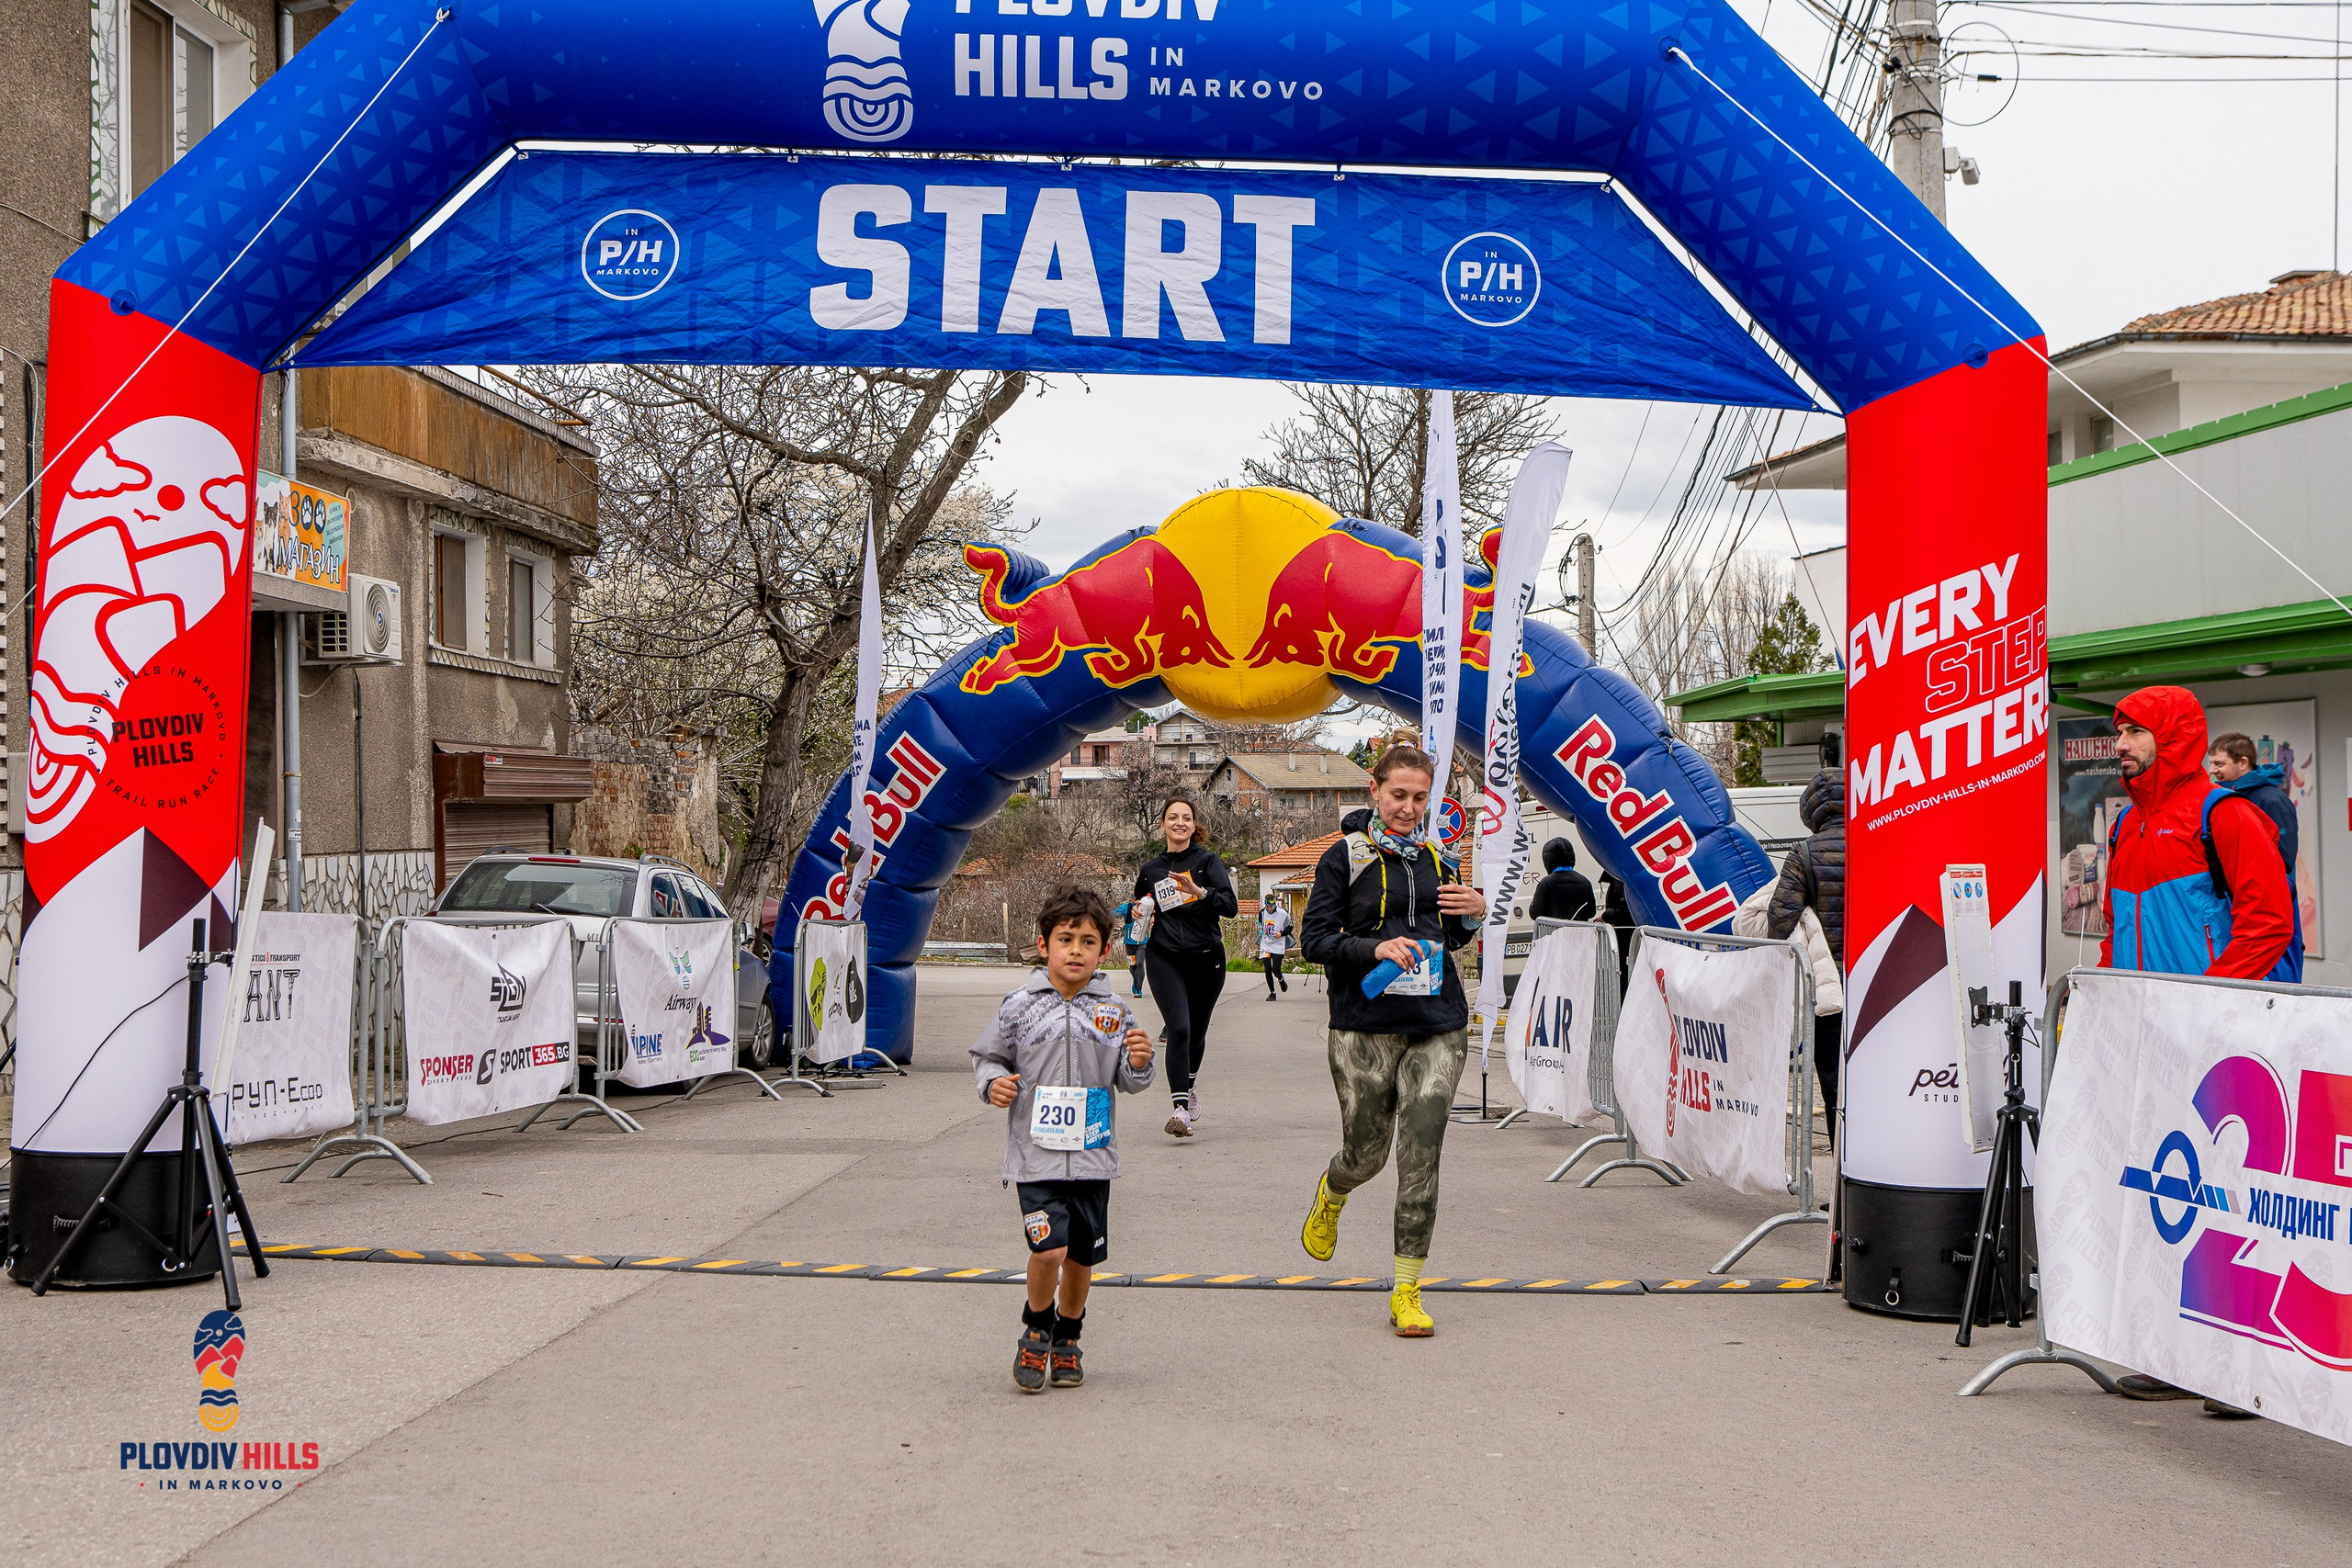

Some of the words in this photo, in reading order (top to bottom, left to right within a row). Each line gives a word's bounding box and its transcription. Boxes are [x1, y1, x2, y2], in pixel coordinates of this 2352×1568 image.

[955, 33, 1128, 100] HILLS
[1150, 47, 1183, 66] IN
[1150, 77, 1323, 100] MARKOVO
[599, 240, 663, 266] P/H
[809, 185, 1316, 345] START
[1485, 251, 1498, 259] IN
[1460, 261, 1522, 292] P/H
[1460, 293, 1522, 304] MARKOVO
[278, 536, 341, 584] МАГАЗИН
[1849, 553, 2019, 690] EVERY
[1925, 604, 2047, 713] STEP
[87, 690, 110, 756] PLOVDIV
[114, 666, 161, 688] HILLS
[171, 666, 186, 678] IN
[192, 676, 226, 740] MARKOVO
[111, 713, 204, 743] PLOVDIV
[132, 741, 194, 768] HILLS
[2064, 736, 2120, 761] НАШЕНС
[106, 778, 147, 807] TRAIL
[158, 796, 187, 808] RUN
[194, 767, 220, 799] RACE
[1867, 750, 2046, 831] WWW.PLOVDIV-HILLS-IN-MARKOVO.COM
[1557, 718, 1670, 835] Red
[1635, 822, 1739, 932] Bull
[1158, 885, 1176, 900] 1319
[270, 953, 300, 962] TRANSPORT
[1673, 1014, 1728, 1064] OVDIV
[420, 1055, 474, 1087] SPONSER
[1713, 1078, 1724, 1092] IN
[1715, 1098, 1759, 1117] MARKOVO
[1924, 1093, 1960, 1103] STUD
[1039, 1104, 1076, 1126] 230
[2247, 1187, 2341, 1242] ХОЛДИНГ
